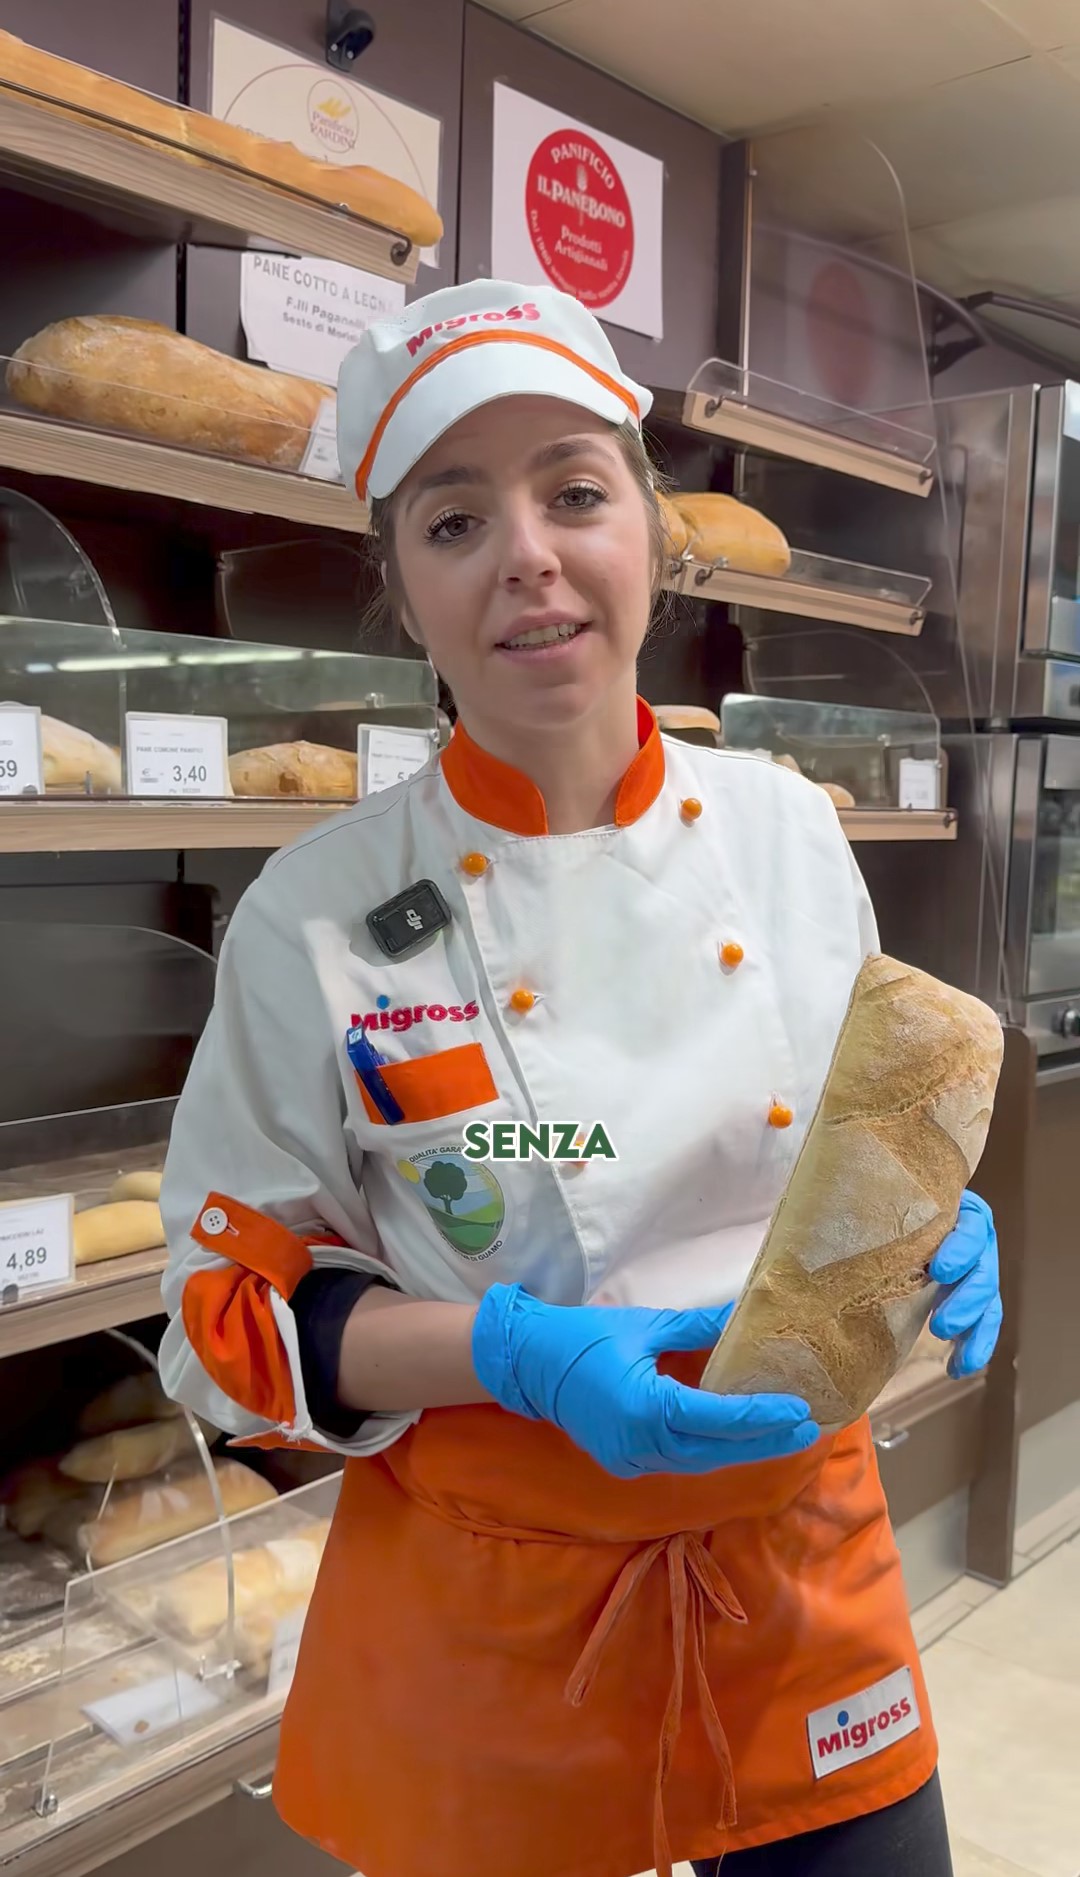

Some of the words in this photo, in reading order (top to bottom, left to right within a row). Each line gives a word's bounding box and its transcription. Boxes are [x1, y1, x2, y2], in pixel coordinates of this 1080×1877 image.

[550, 142, 616, 190] PANIFICIO
[561, 224, 602, 254] Prodotti
[253, 255, 290, 281] PANE
[293, 269, 338, 297] COTTO
[341, 287, 350, 300] A
[405, 303, 541, 358] Migross
[172, 764, 207, 785] 3,40
[350, 994, 481, 1033] Migross
[6, 1246, 48, 1271] 4,89
[478, 1239, 503, 1261] GUAMO
[816, 1696, 912, 1759] Migross
